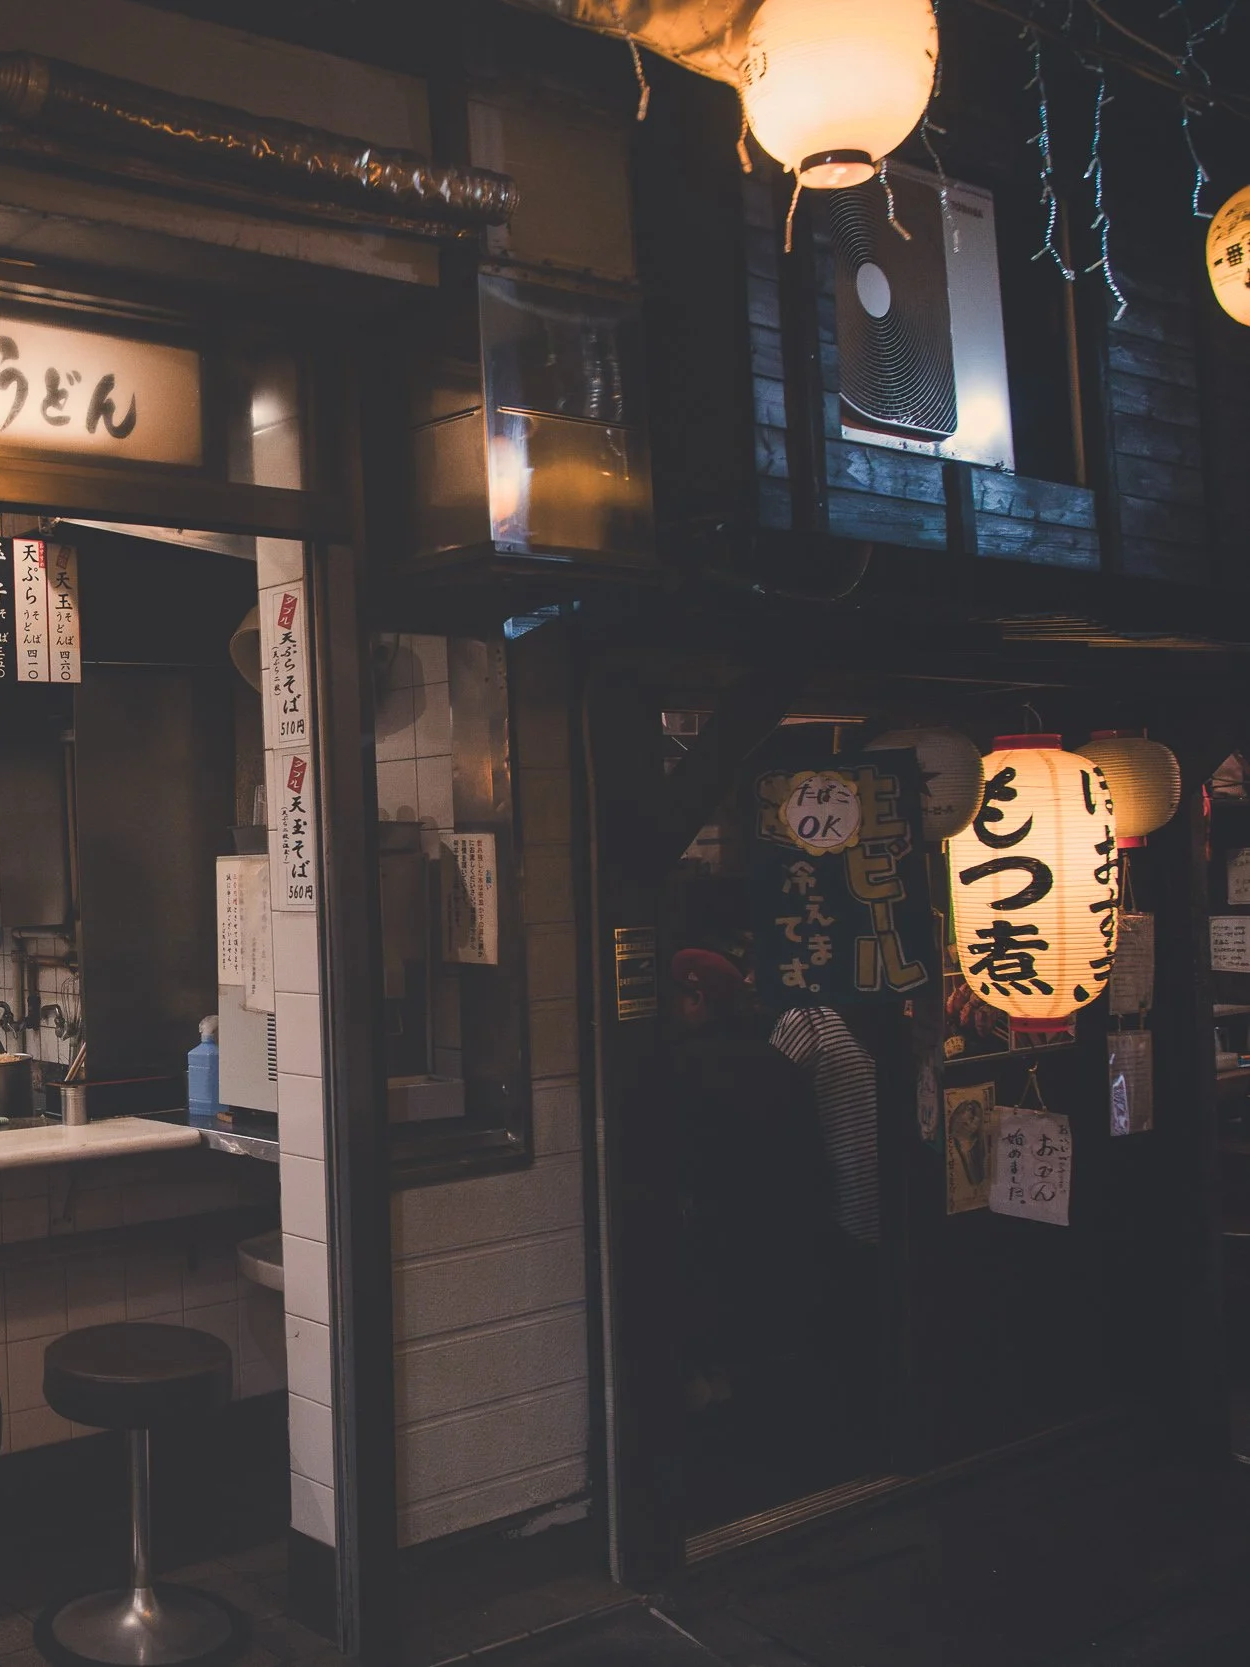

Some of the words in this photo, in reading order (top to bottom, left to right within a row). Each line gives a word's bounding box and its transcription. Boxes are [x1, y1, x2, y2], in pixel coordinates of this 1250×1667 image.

[22, 544, 40, 604] 天ぷら
[54, 572, 73, 610] 天玉
[27, 650, 38, 680] 四一〇
[60, 651, 71, 681] 四六〇
[279, 632, 301, 714] 天ぷらそば
[281, 719, 304, 736] 510円
[797, 778, 850, 807] たばこ
[289, 796, 310, 878] 天玉そば
[798, 815, 842, 839] OK
[289, 885, 313, 900] 560円
[959, 767, 1054, 997] もつ煮
[1036, 1133, 1060, 1202] おでん
